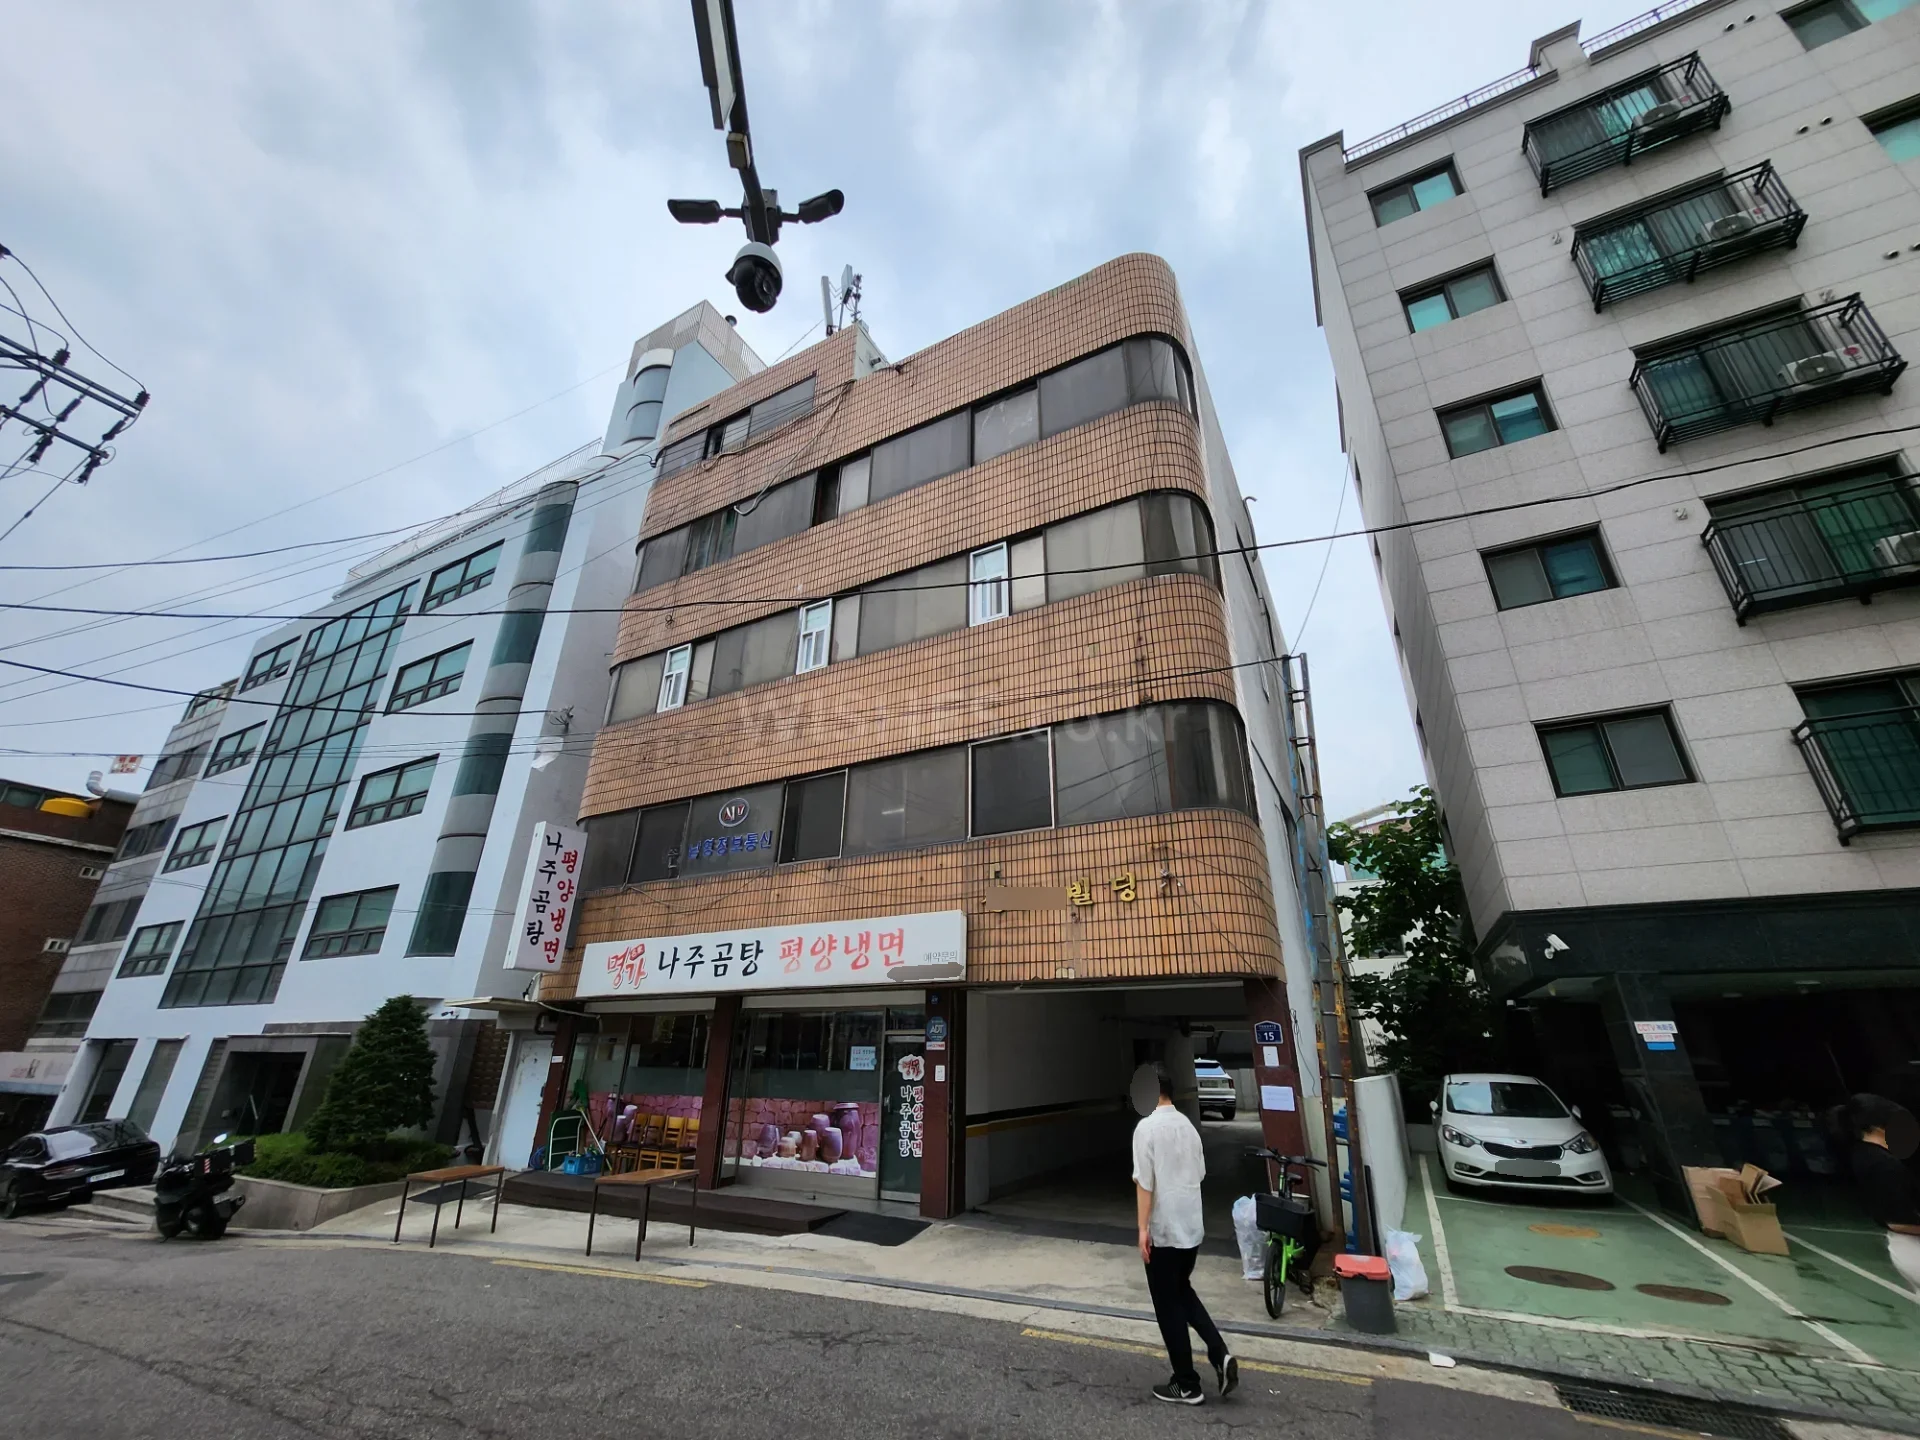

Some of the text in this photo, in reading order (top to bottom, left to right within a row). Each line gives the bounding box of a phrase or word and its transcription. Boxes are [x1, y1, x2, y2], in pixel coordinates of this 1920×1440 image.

[527, 832, 564, 946] 나주곰탕
[544, 849, 578, 964] 평양냉면
[607, 928, 905, 988] 명가 나주곰탕 평양냉면
[923, 950, 958, 963] 예약문의
[930, 1025, 944, 1034] ADT
[1263, 1032, 1275, 1041] 15
[899, 1086, 912, 1157] 나주곰탕
[912, 1086, 925, 1157] 평양냉면
